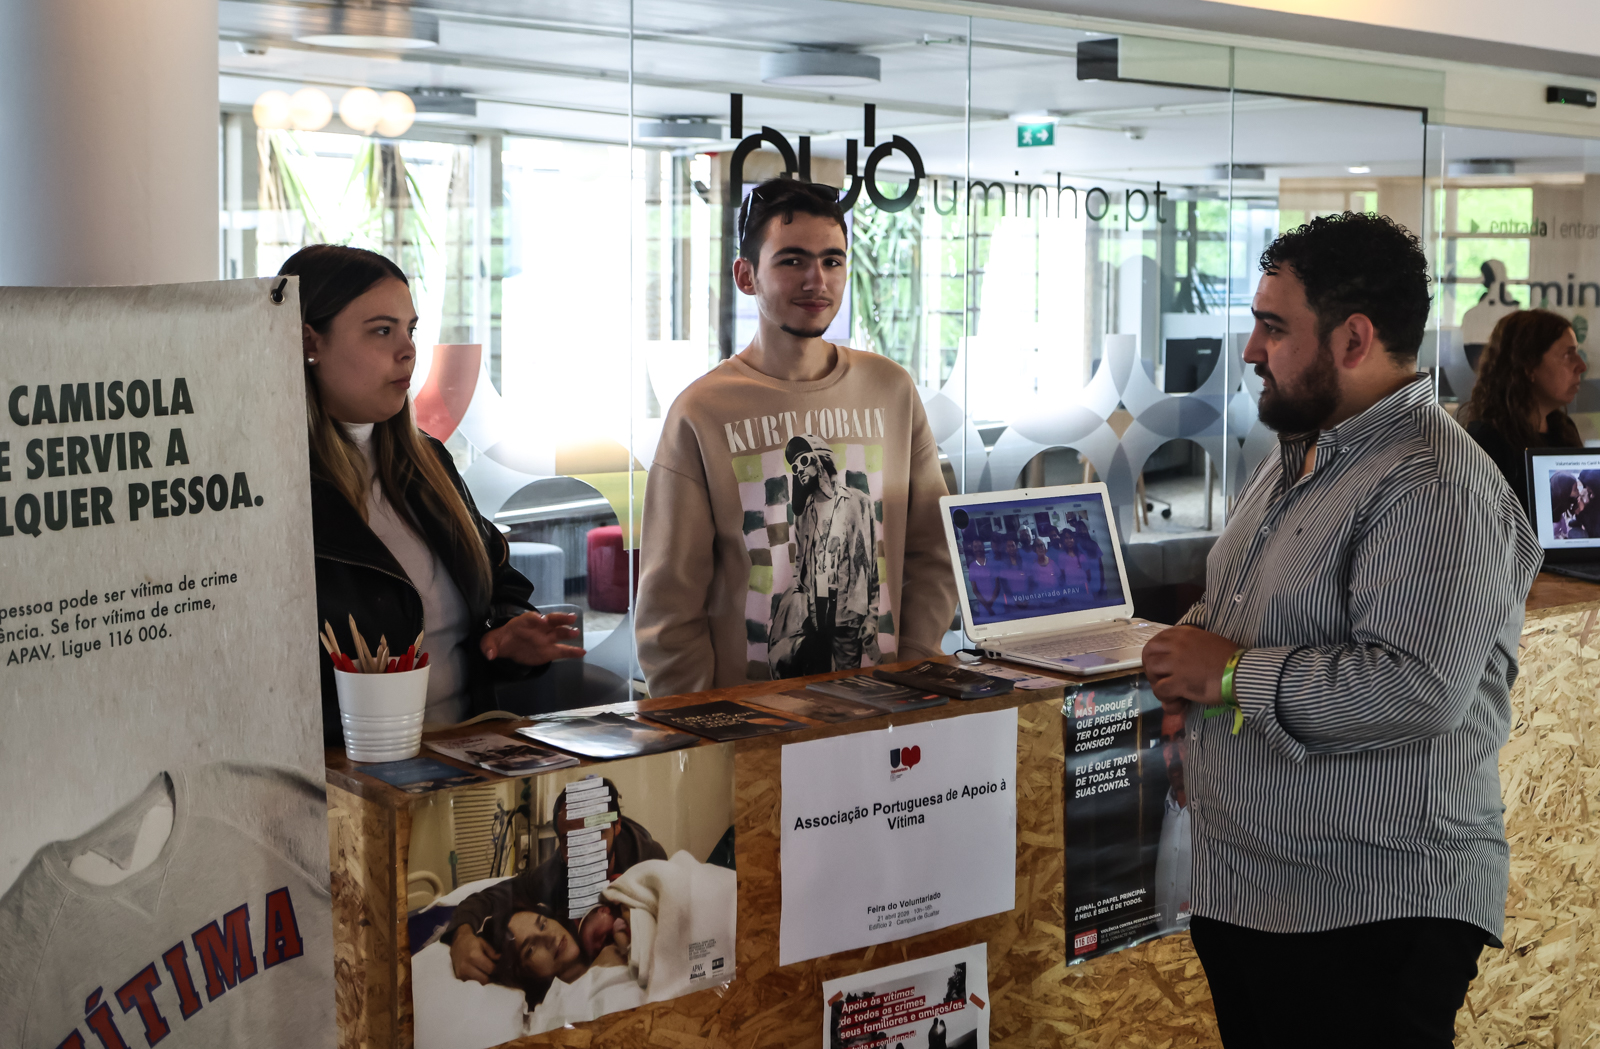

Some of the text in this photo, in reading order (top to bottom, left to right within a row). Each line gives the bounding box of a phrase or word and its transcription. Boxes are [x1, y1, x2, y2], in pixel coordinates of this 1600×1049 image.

[1490, 217, 1547, 237] entrada
[8, 377, 194, 426] CAMISOLA
[723, 407, 886, 453] KURT COBAIN
[25, 431, 153, 480] SERVIR
[165, 428, 190, 466] A
[128, 471, 264, 521] PESSOA.
[0, 571, 238, 625] pessoa pode ser vítima de crime
[1013, 587, 1081, 602] Voluntariado APAV
[51, 618, 70, 636] Se
[75, 613, 97, 632] for
[102, 609, 146, 627] vítima
[151, 600, 169, 618] de
[174, 596, 216, 613] crime,
[6, 624, 173, 667] APAV. Ligue 116 006.
[1075, 697, 1133, 718] MAS PORQUE É
[1076, 708, 1140, 730] QUE PRECISA DE
[1076, 720, 1133, 742] TER O CARTÃO
[1075, 736, 1114, 752] CONSIGO?
[1075, 753, 1138, 776] EU É QUE TRATO
[1075, 767, 1127, 788] DE TODAS AS
[1075, 778, 1130, 799] SUAS CONTAS.
[794, 778, 1007, 831] Associação Portuguesa de Apoio à
[887, 812, 925, 830] Vítima
[867, 892, 941, 914] Feira do Voluntariado
[1074, 903, 1097, 914] AFINAL,
[1102, 896, 1119, 905] PAPEL
[1119, 887, 1146, 901] PRINCIPAL
[55, 886, 304, 1049] ÍTIMA
[841, 989, 915, 1014] Apoio às vítimas
[840, 1015, 852, 1026] de
[854, 1010, 880, 1021] todos
[882, 1007, 892, 1015] os
[840, 1027, 861, 1039] seus
[863, 1016, 908, 1033] familiares
[910, 1013, 916, 1021] e
[876, 1031, 917, 1047] confidencial
